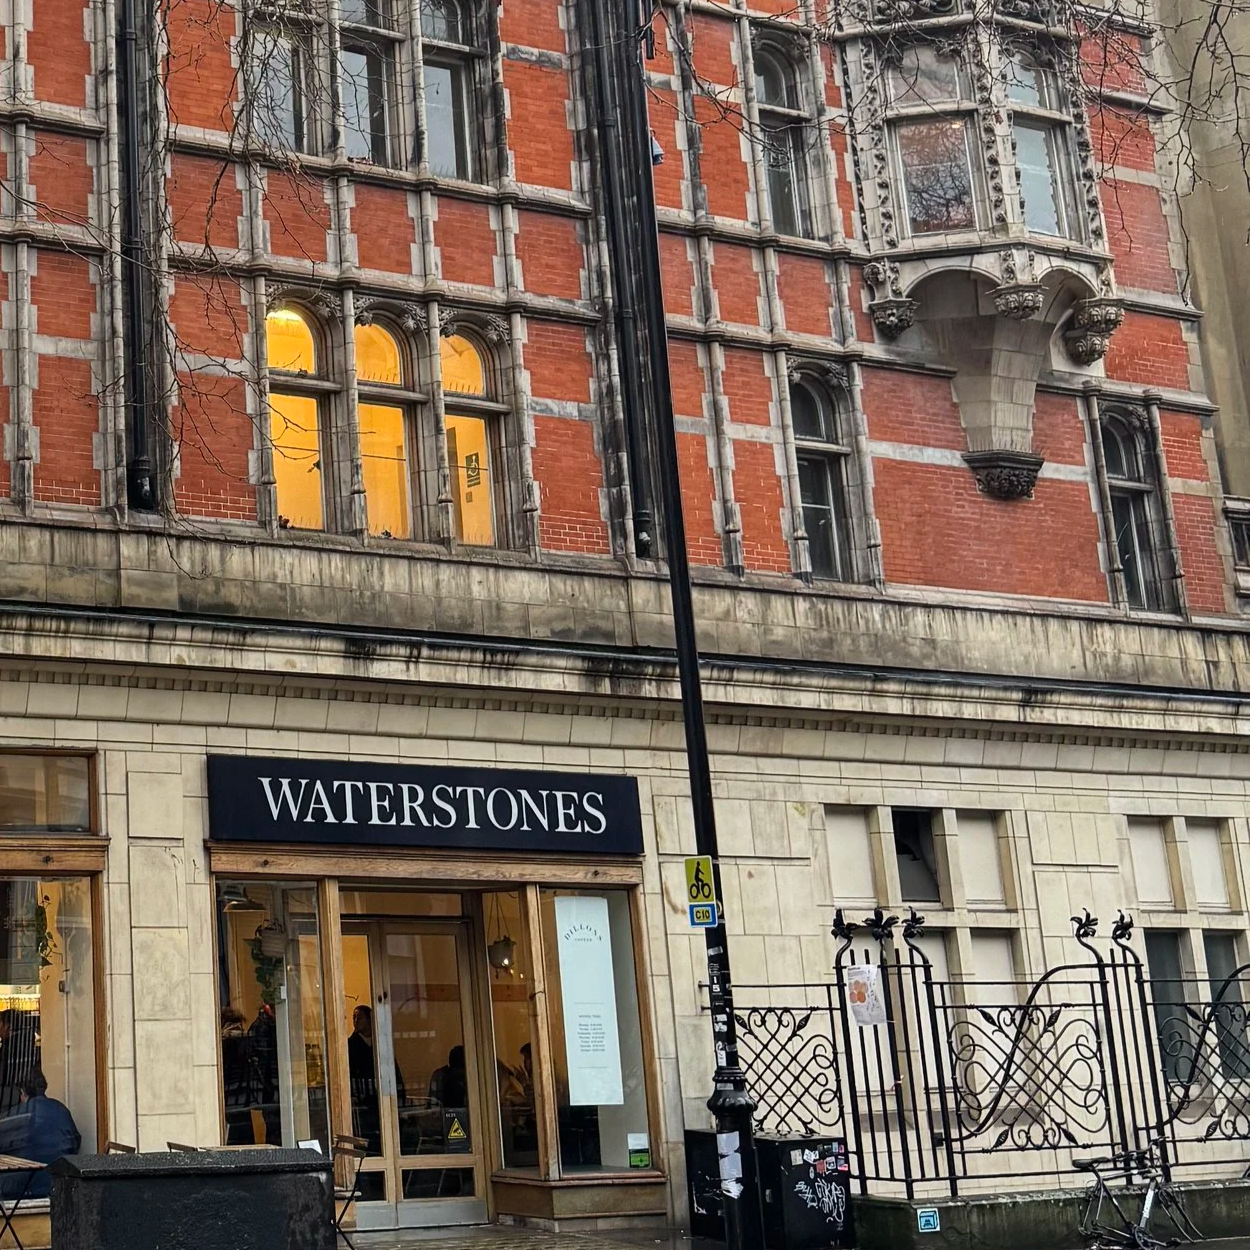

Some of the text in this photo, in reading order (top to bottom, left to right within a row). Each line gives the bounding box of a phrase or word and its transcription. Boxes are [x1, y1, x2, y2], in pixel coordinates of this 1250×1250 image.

[258, 777, 607, 834] WATERSTONES
[695, 910, 710, 919] C10
[564, 924, 603, 941] DILLONS
